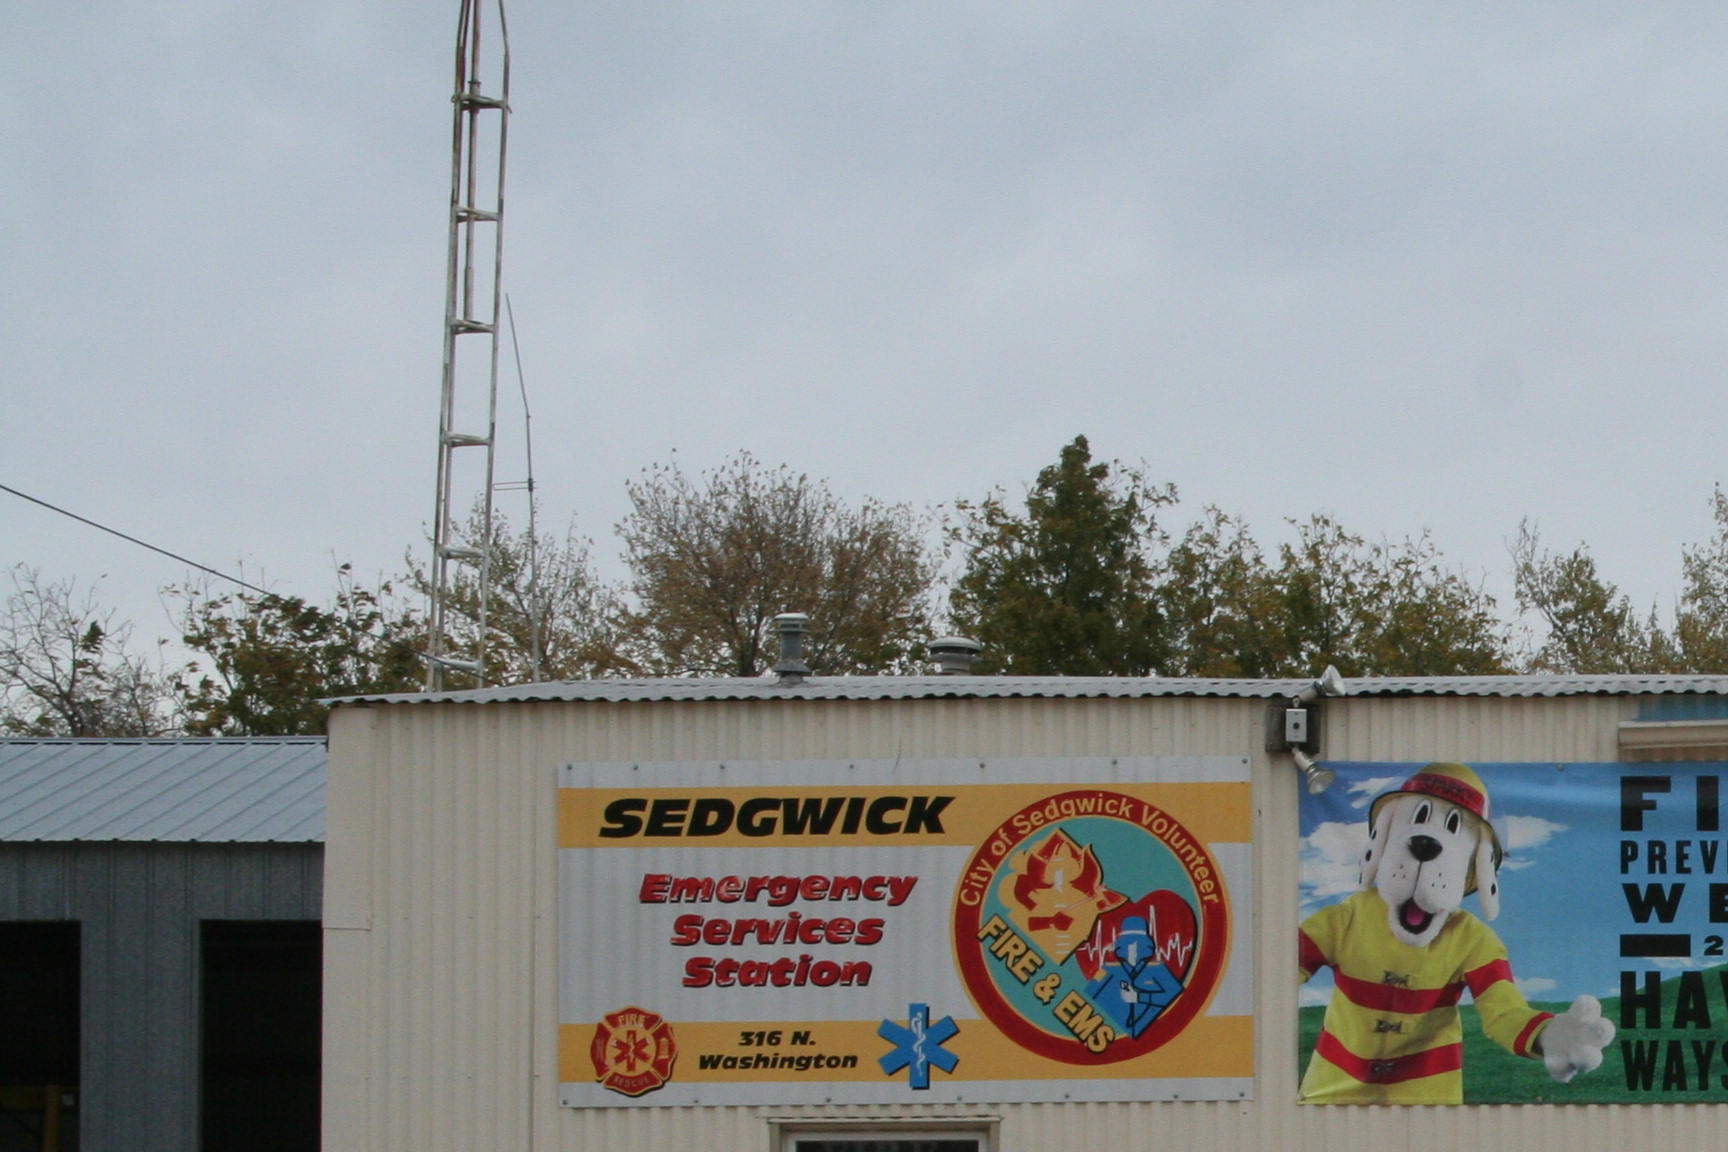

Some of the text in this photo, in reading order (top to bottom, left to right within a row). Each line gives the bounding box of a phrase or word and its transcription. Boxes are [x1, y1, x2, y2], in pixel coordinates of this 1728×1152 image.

[599, 796, 956, 838] SEDGWICK
[960, 793, 1219, 906] City of Sedgwick Volunteer
[639, 873, 918, 906] Emergency
[670, 912, 885, 946] Services
[681, 955, 873, 989] Station
[977, 913, 1116, 1053] FIRE & EMS
[617, 1013, 646, 1028] FIRE
[738, 1031, 816, 1046] 316 N.
[699, 1053, 858, 1071] Washington
[613, 1076, 650, 1088] RESCUE
